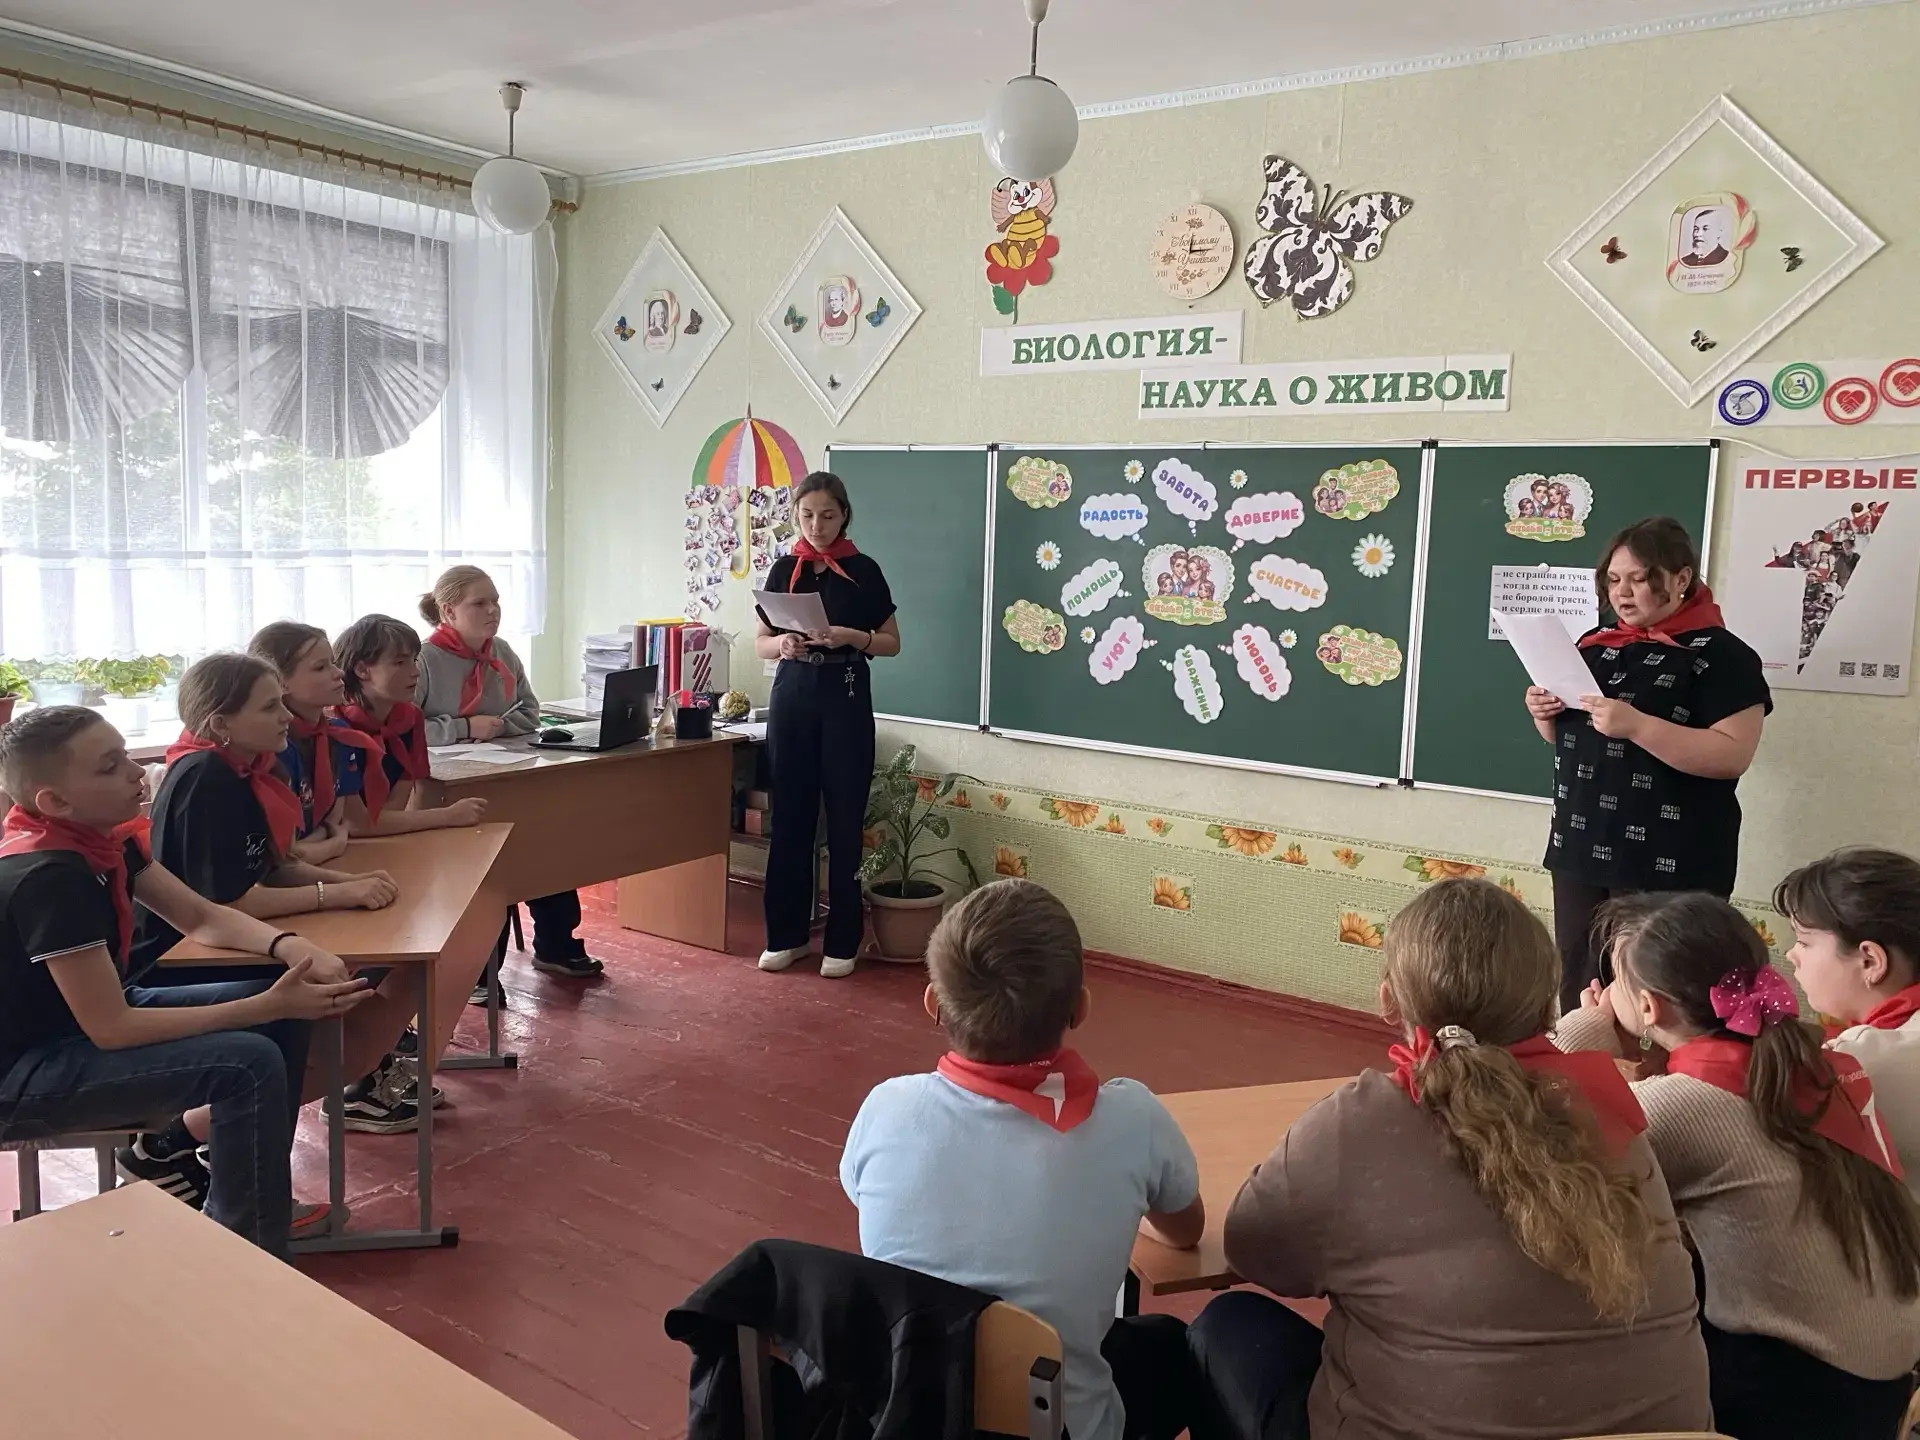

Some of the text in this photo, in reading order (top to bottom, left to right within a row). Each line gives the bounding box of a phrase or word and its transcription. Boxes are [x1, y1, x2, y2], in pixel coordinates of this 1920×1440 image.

[1011, 326, 1228, 364] БИОЛОГИЯ-
[1141, 369, 1508, 410] НАУКА О ЖИВОМ
[1158, 469, 1210, 512] ЗАБОТА
[1745, 468, 1918, 489] ПЕРВЫЕ
[1083, 508, 1144, 523] РАДОСТЬ
[1230, 507, 1300, 528] ДОВЕРИЕ
[1065, 567, 1118, 610] ПОМОЩЬ
[1256, 568, 1322, 600] СЧАСТЬЕ
[1503, 583, 1530, 591] когда
[1541, 584, 1568, 592] семье
[1516, 571, 1557, 581] страшна
[1515, 592, 1554, 603] бородой
[1558, 608, 1586, 616] месте.
[1102, 631, 1132, 671] УЮТ
[1240, 633, 1277, 694] ЛЮБОВЬ
[1181, 648, 1212, 721] УВАЖЕНИЕ
